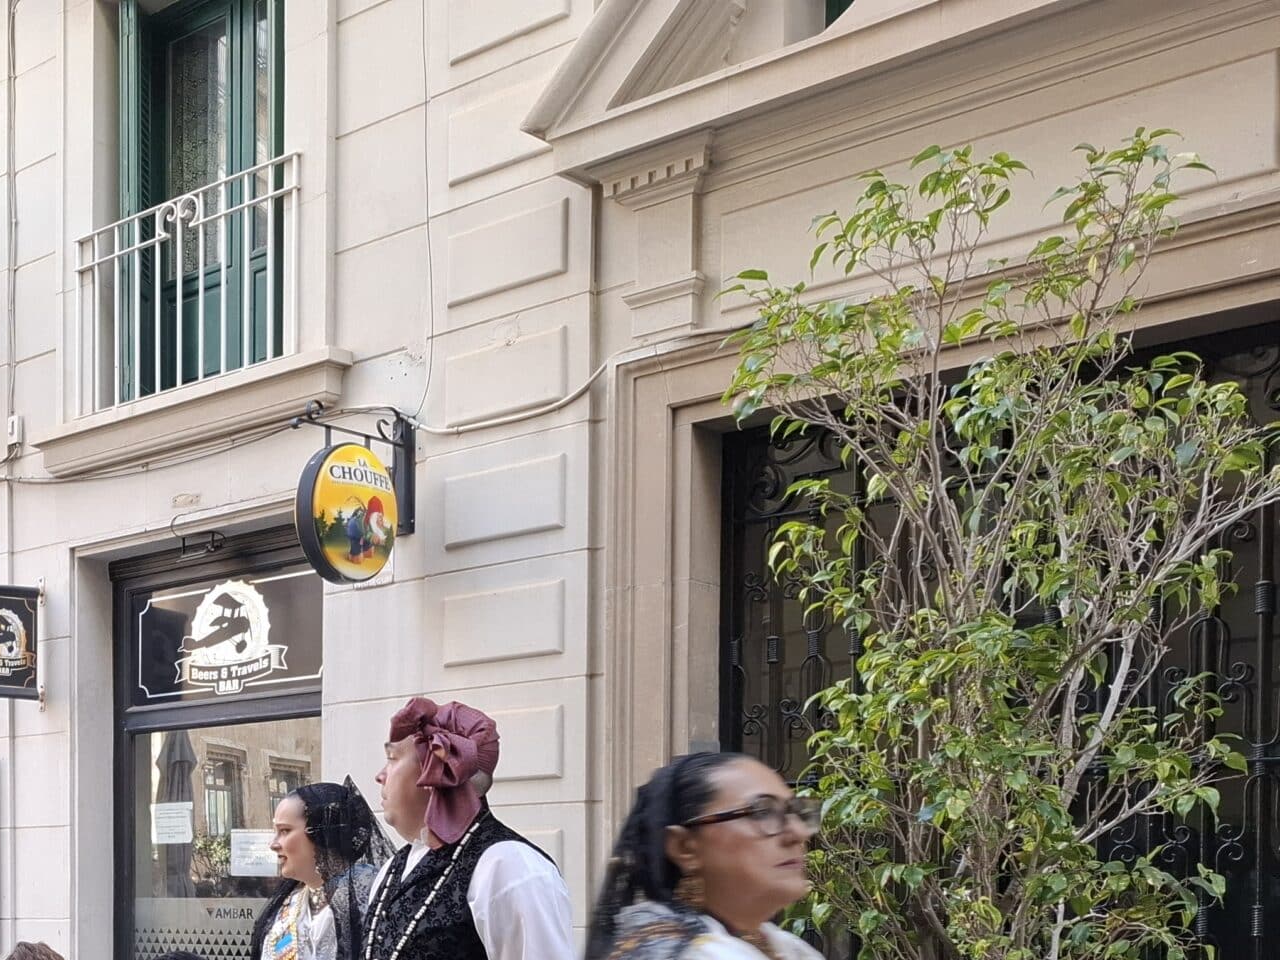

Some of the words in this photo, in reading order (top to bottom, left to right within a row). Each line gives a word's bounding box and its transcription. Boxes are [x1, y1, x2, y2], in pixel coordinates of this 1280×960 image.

[358, 459, 368, 468] LA
[329, 464, 391, 490] CHOUFFE
[191, 667, 219, 680] Beers
[220, 667, 228, 679] &
[230, 657, 269, 677] Travels
[219, 679, 239, 692] BAR
[215, 907, 254, 920] AMBAR
